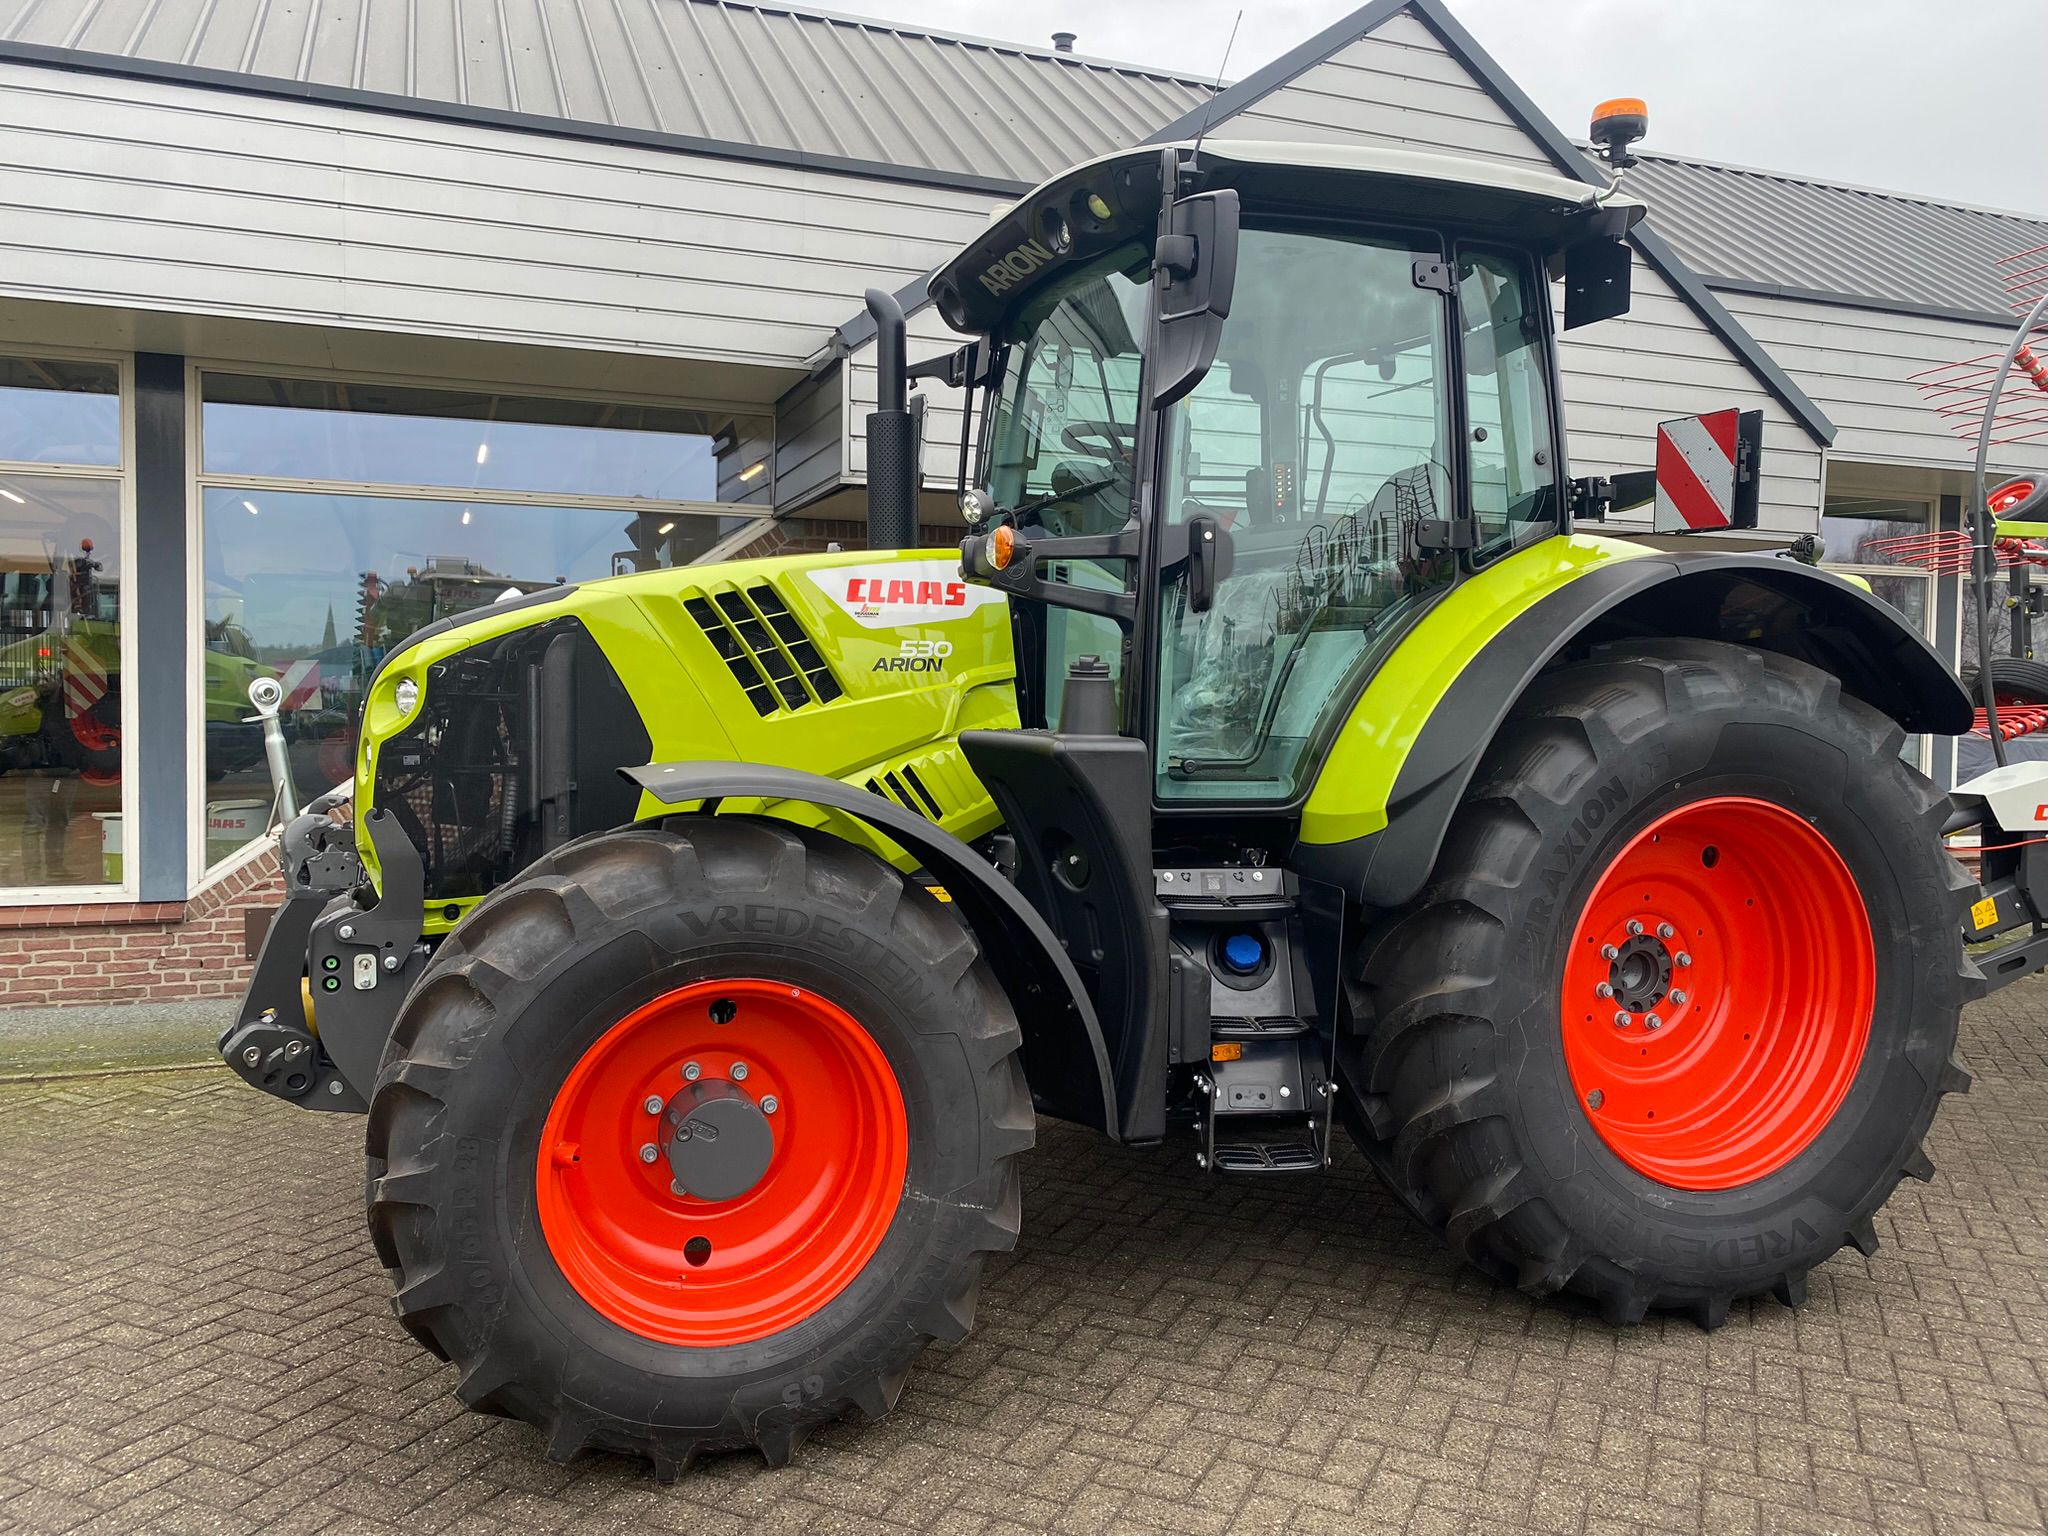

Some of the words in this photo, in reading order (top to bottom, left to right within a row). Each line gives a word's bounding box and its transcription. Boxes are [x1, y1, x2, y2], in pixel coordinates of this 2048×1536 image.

[979, 238, 1055, 296] ARION
[846, 578, 966, 605] CLAAS
[900, 640, 953, 658] 530
[872, 657, 943, 672] ARION
[208, 818, 246, 828] LAAS
[676, 904, 936, 1010] VREDESTEIN
